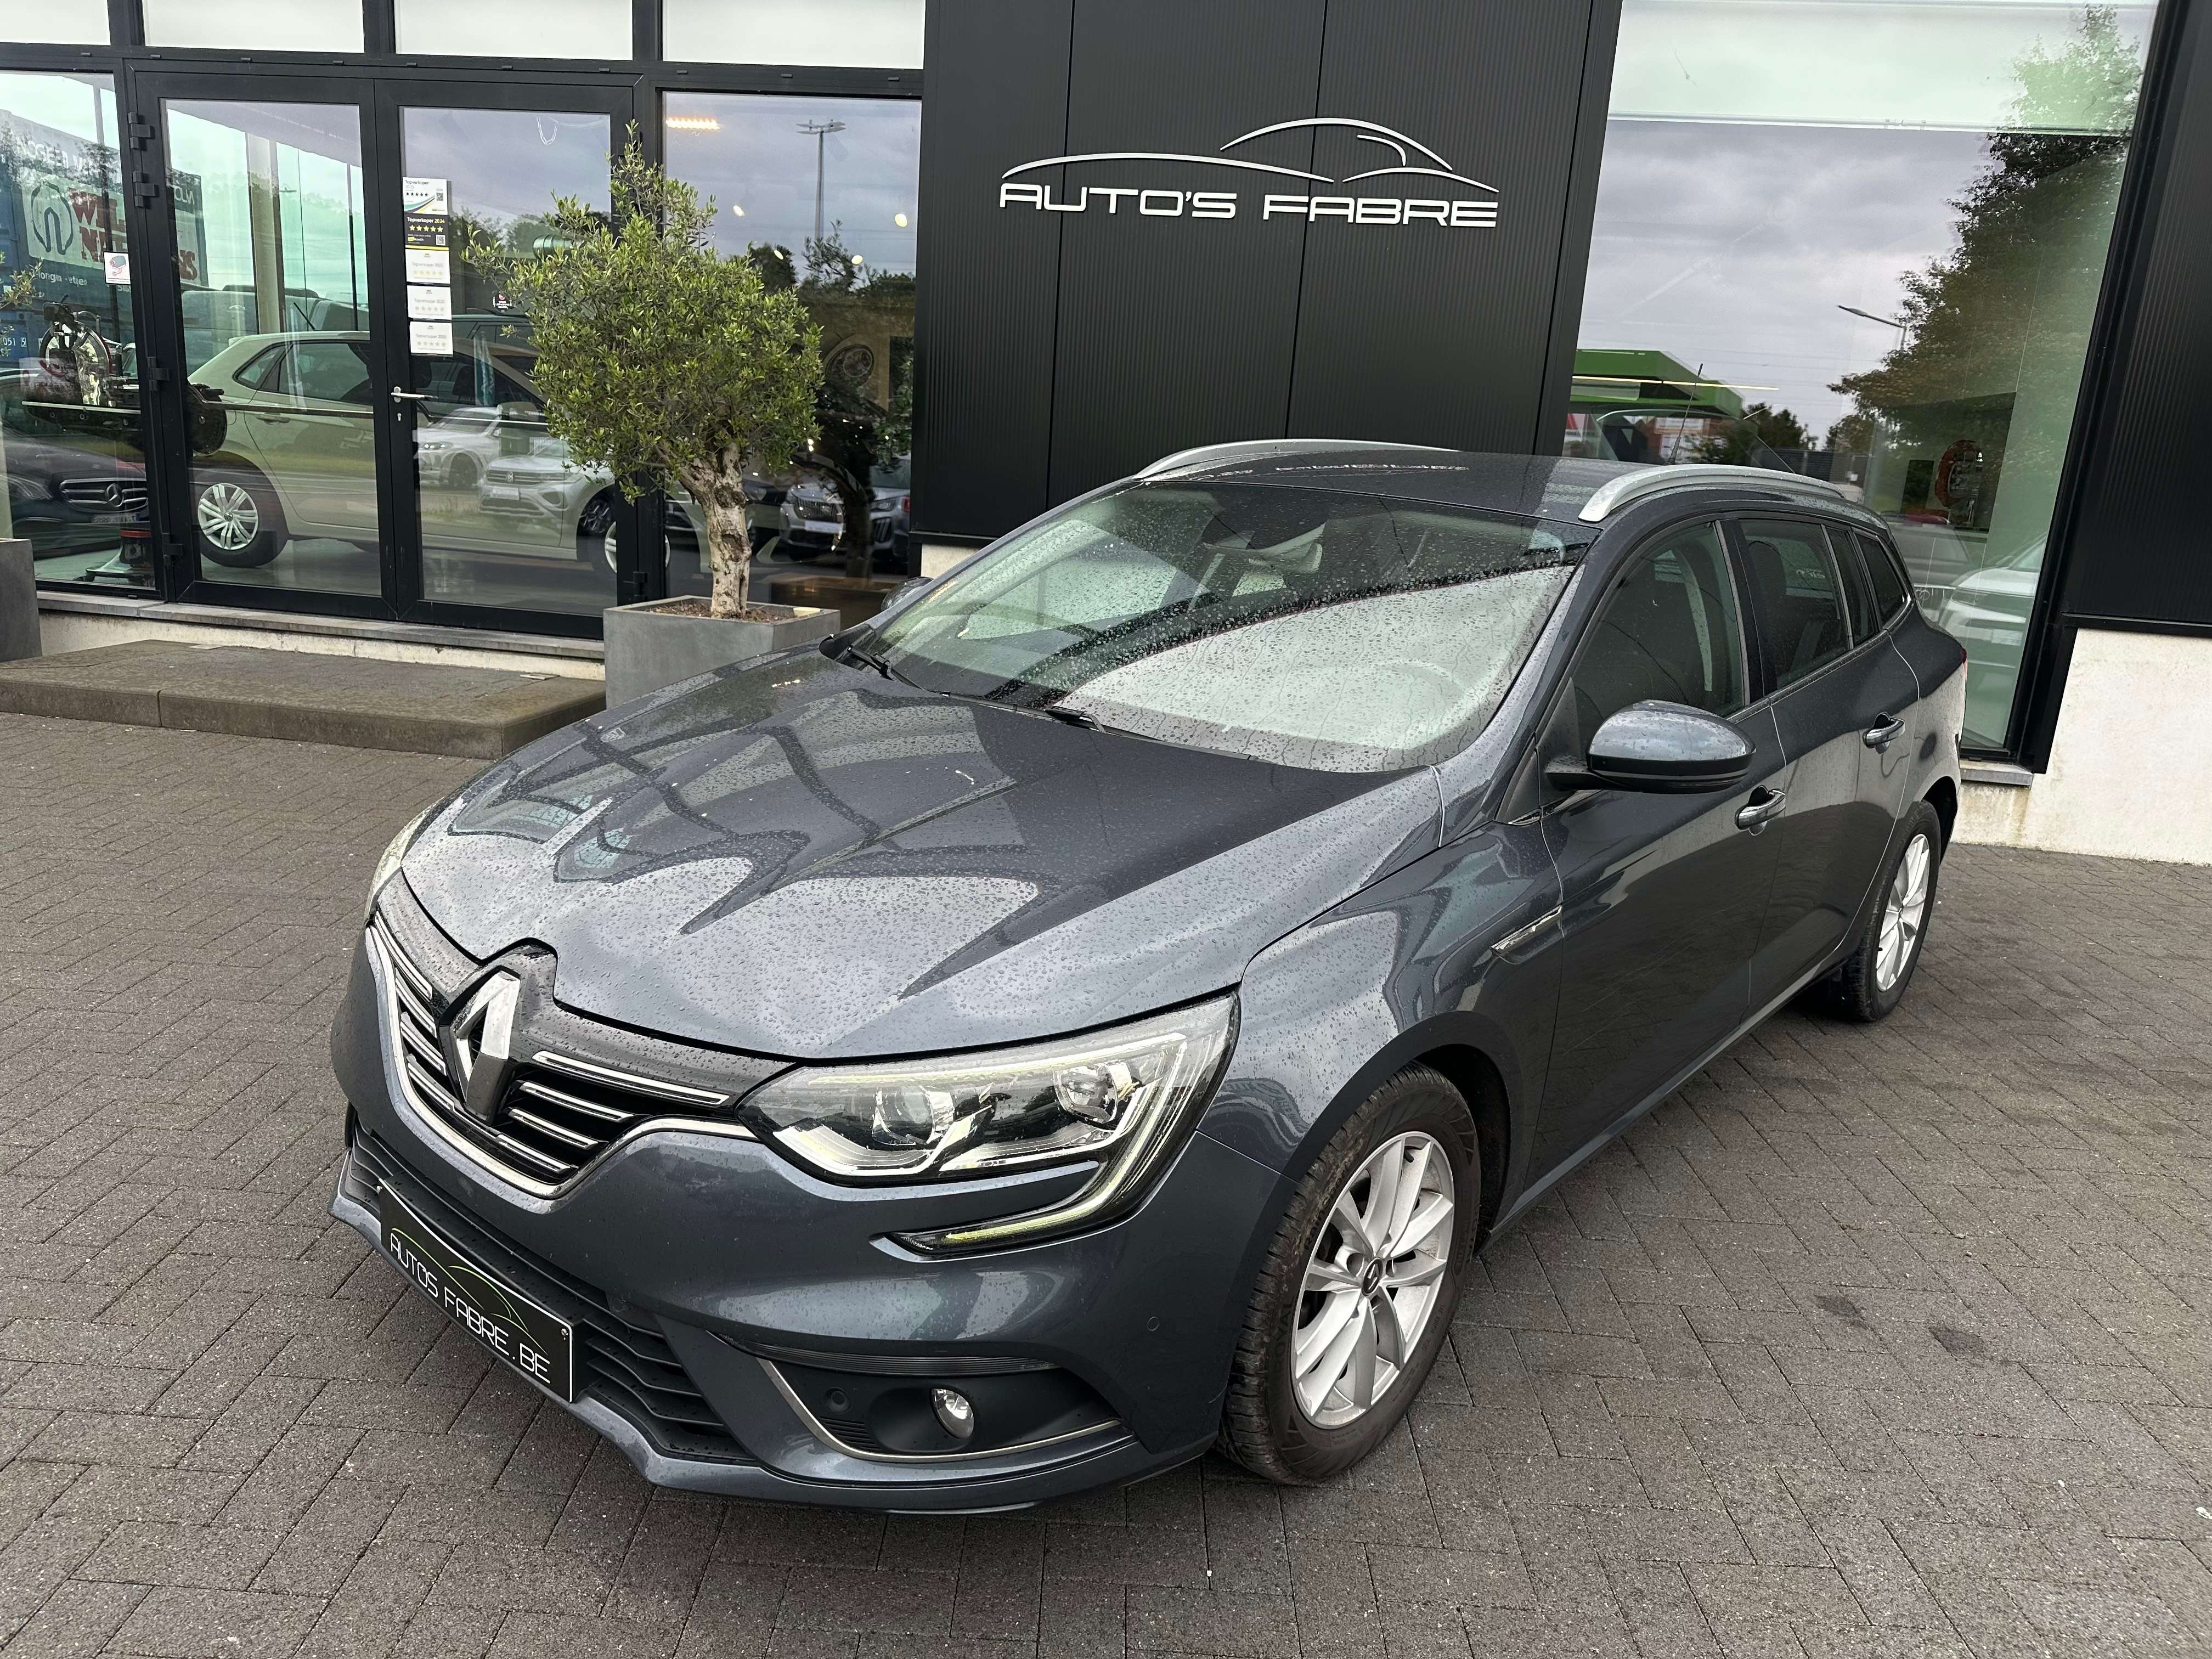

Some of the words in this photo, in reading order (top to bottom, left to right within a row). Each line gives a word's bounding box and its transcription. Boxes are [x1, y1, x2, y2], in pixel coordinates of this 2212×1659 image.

[1000, 183, 1237, 219] AUTO'S
[1263, 195, 1499, 228] FABRE
[390, 1233, 438, 1298] AUTOS
